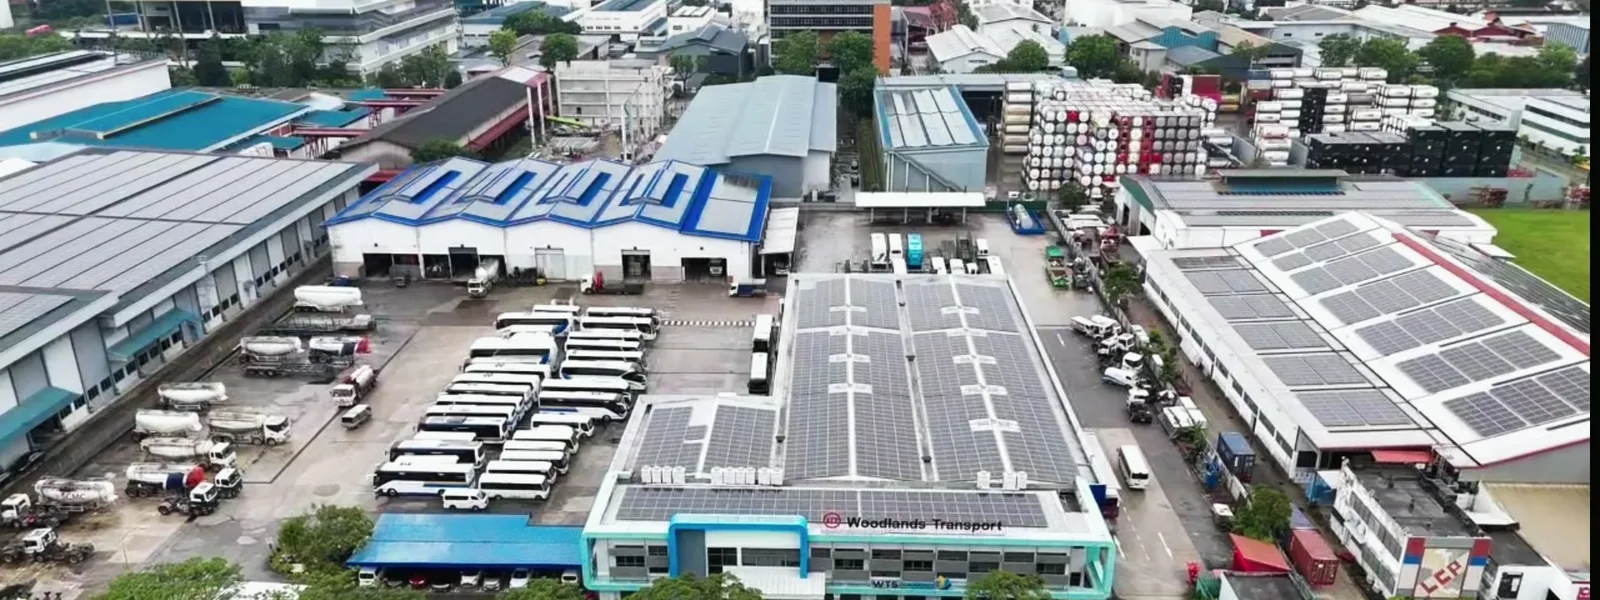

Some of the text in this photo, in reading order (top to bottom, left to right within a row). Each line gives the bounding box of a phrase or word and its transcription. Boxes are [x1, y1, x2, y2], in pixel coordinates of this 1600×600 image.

[847, 517, 926, 529] Woodlands
[932, 518, 1002, 533] Transport
[873, 580, 898, 588] WTS
